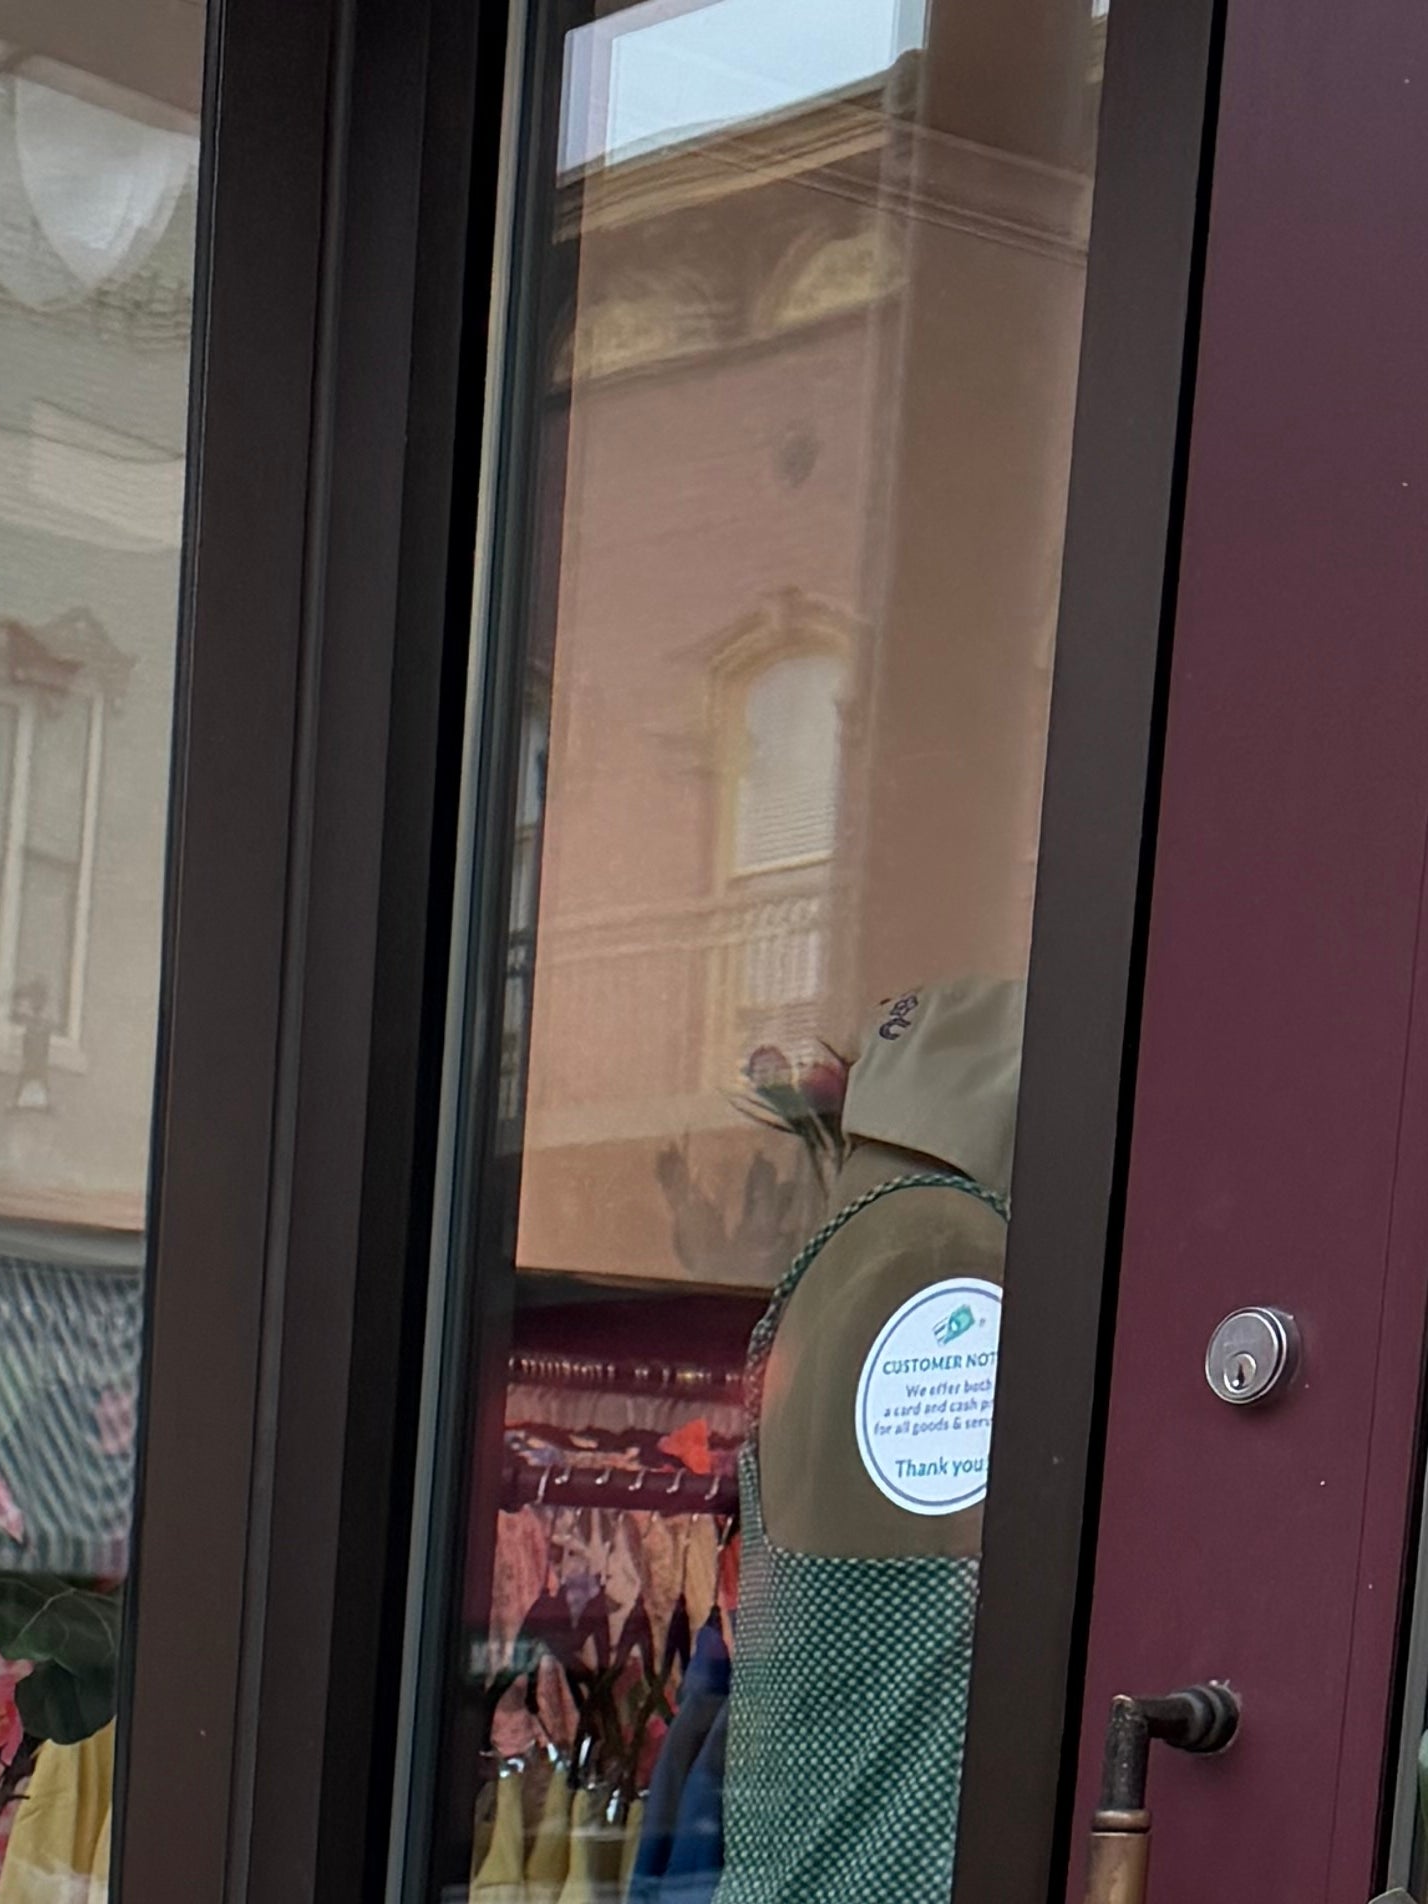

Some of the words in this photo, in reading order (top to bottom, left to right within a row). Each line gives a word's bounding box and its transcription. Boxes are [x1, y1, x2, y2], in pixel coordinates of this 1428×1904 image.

[882, 1355, 963, 1375] CUSTOMER
[905, 1384, 927, 1397] We
[929, 1382, 961, 1395] offer
[883, 1407, 891, 1417] a
[893, 1401, 921, 1417] card
[924, 1400, 947, 1414] and
[949, 1397, 978, 1412] cash
[874, 1421, 892, 1435] for
[895, 1421, 910, 1434] all
[912, 1417, 949, 1436] goods
[952, 1416, 962, 1430] &
[895, 1456, 948, 1478] Thank
[952, 1457, 988, 1477] you
